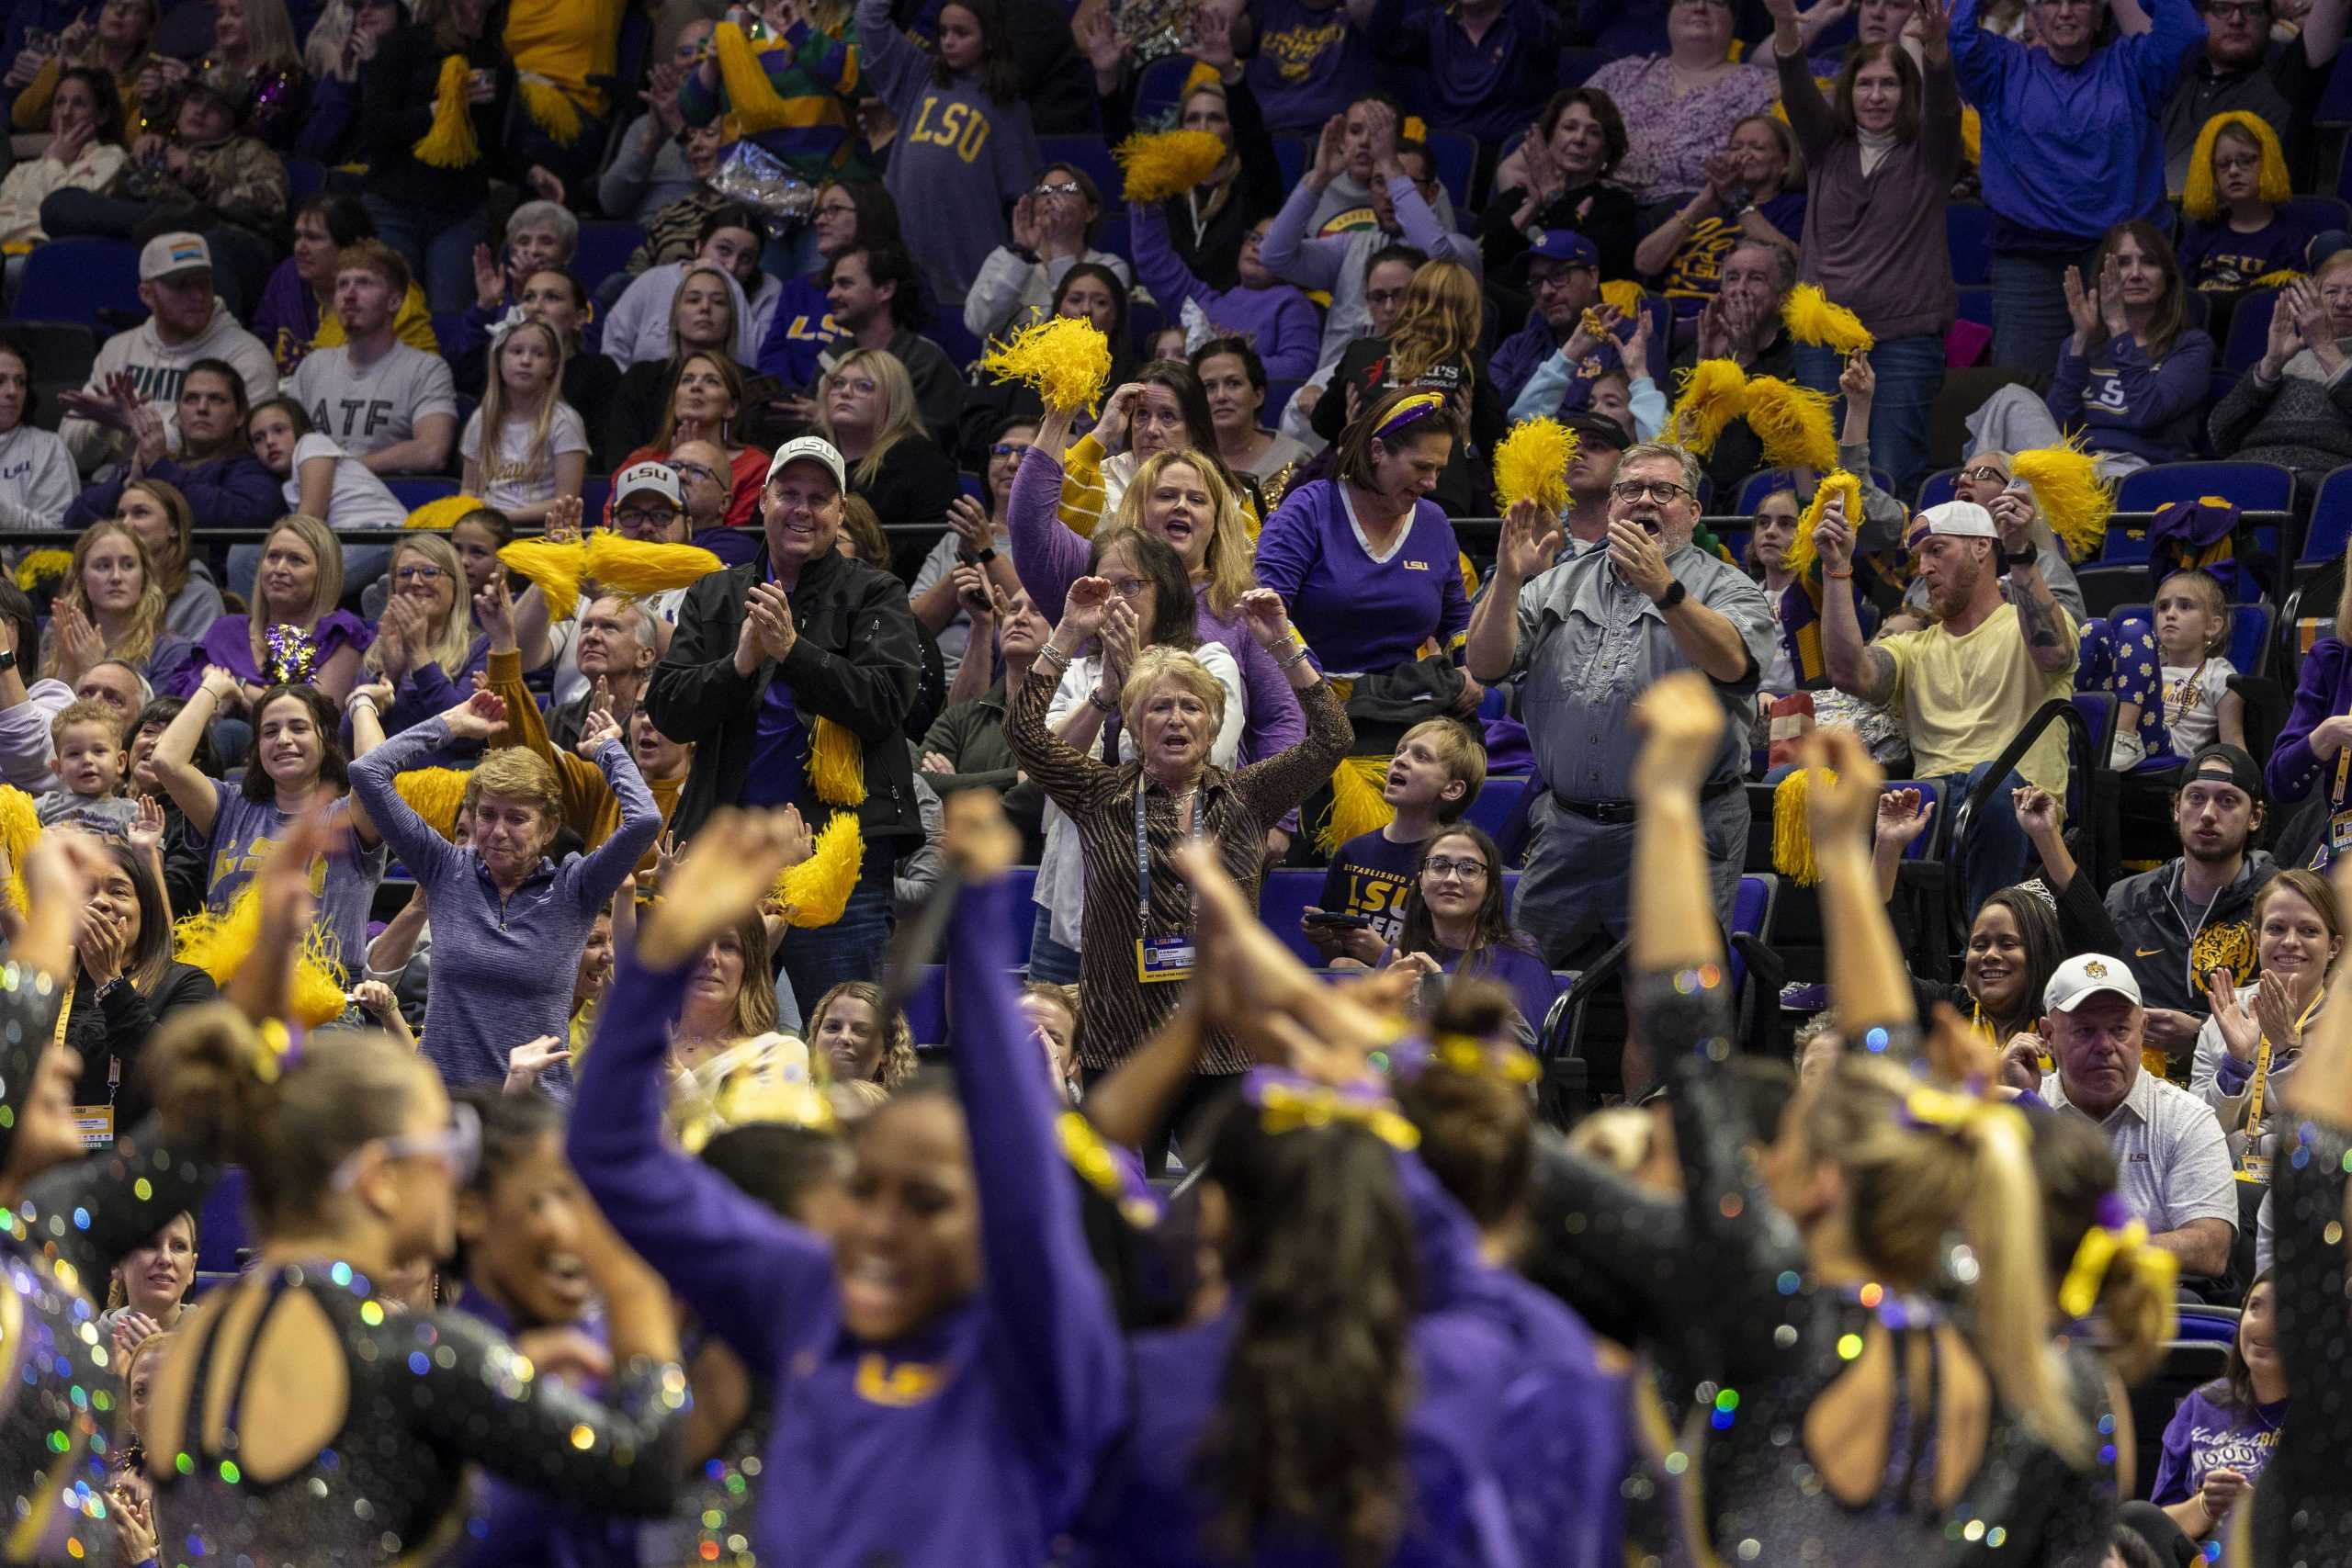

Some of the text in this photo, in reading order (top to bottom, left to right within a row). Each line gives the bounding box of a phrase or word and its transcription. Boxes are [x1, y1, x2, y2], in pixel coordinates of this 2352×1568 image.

[910, 96, 990, 163] LSU
[789, 439, 835, 461] LSU
[627, 467, 669, 484] LSU
[1403, 559, 1429, 570] LSU
[1343, 863, 1407, 884] ESTABLISHED
